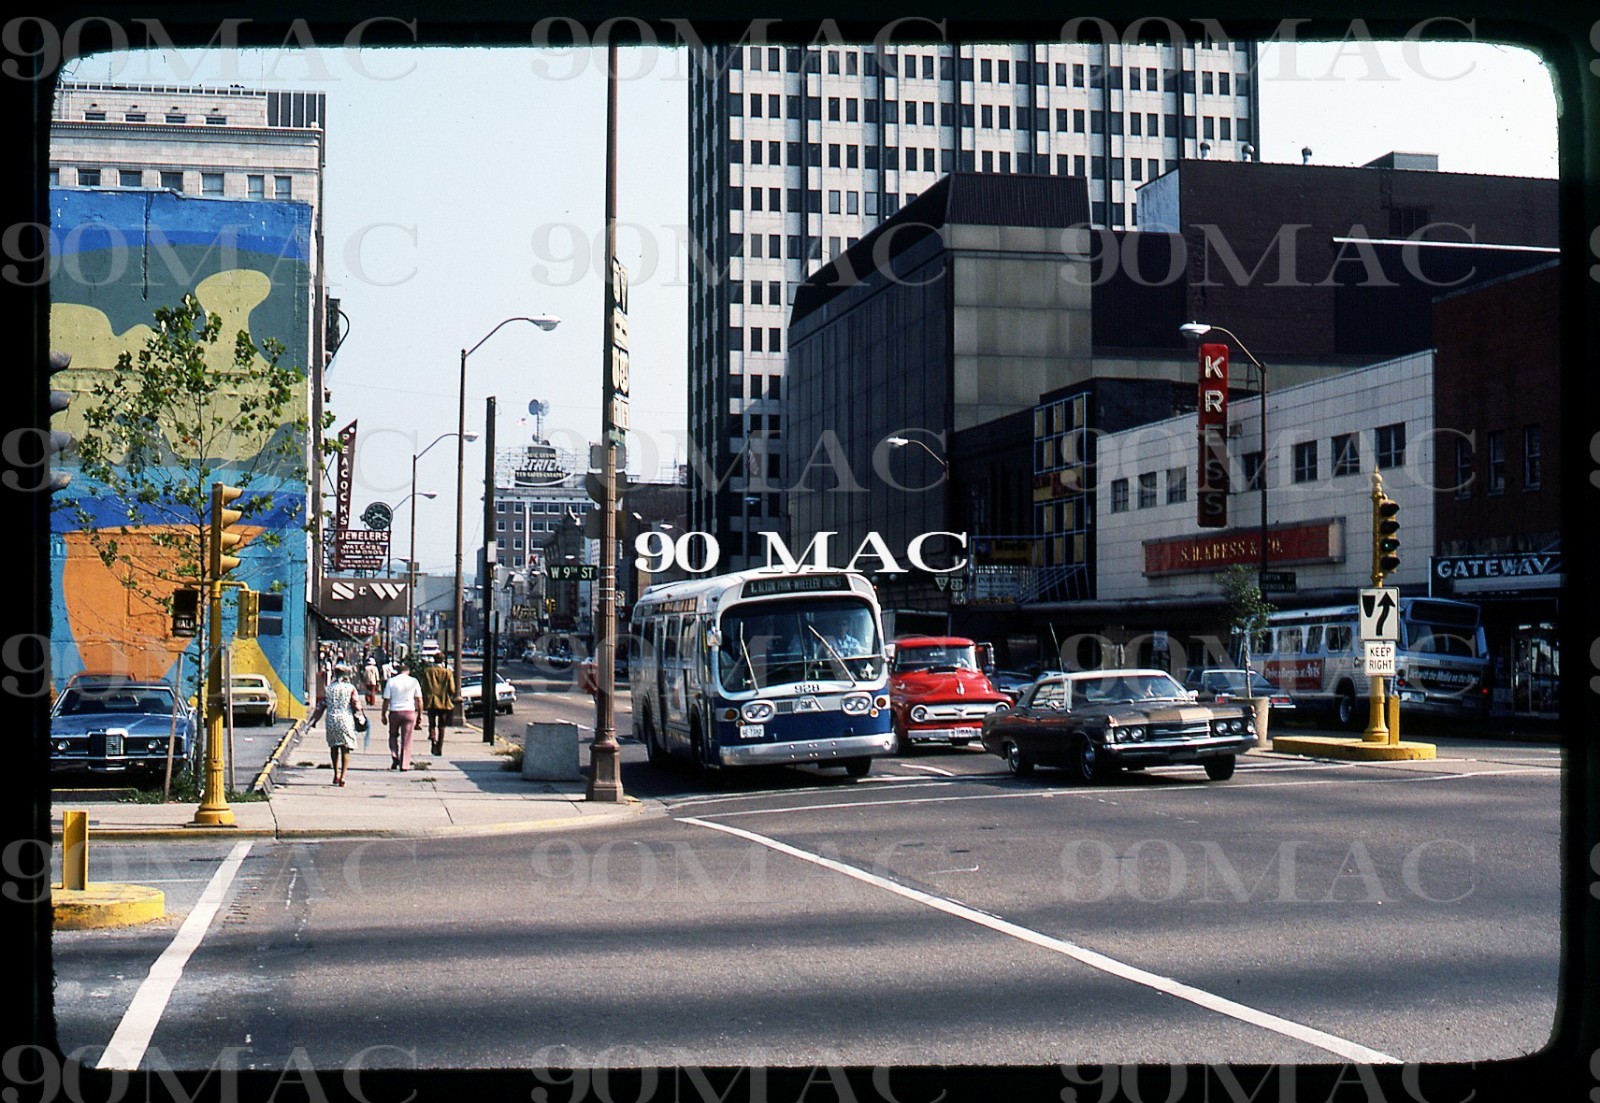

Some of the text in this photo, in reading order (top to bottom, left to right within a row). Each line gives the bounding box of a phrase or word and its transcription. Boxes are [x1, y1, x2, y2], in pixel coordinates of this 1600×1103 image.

[1204, 355, 1225, 515] KRESS
[338, 531, 389, 541] JEWELERS
[550, 567, 594, 578] W 9TH ST
[332, 582, 355, 600] S
[369, 582, 406, 600] W
[1370, 646, 1391, 657] KEEP
[1369, 659, 1392, 670] RIGHT
[794, 684, 820, 694] 928
